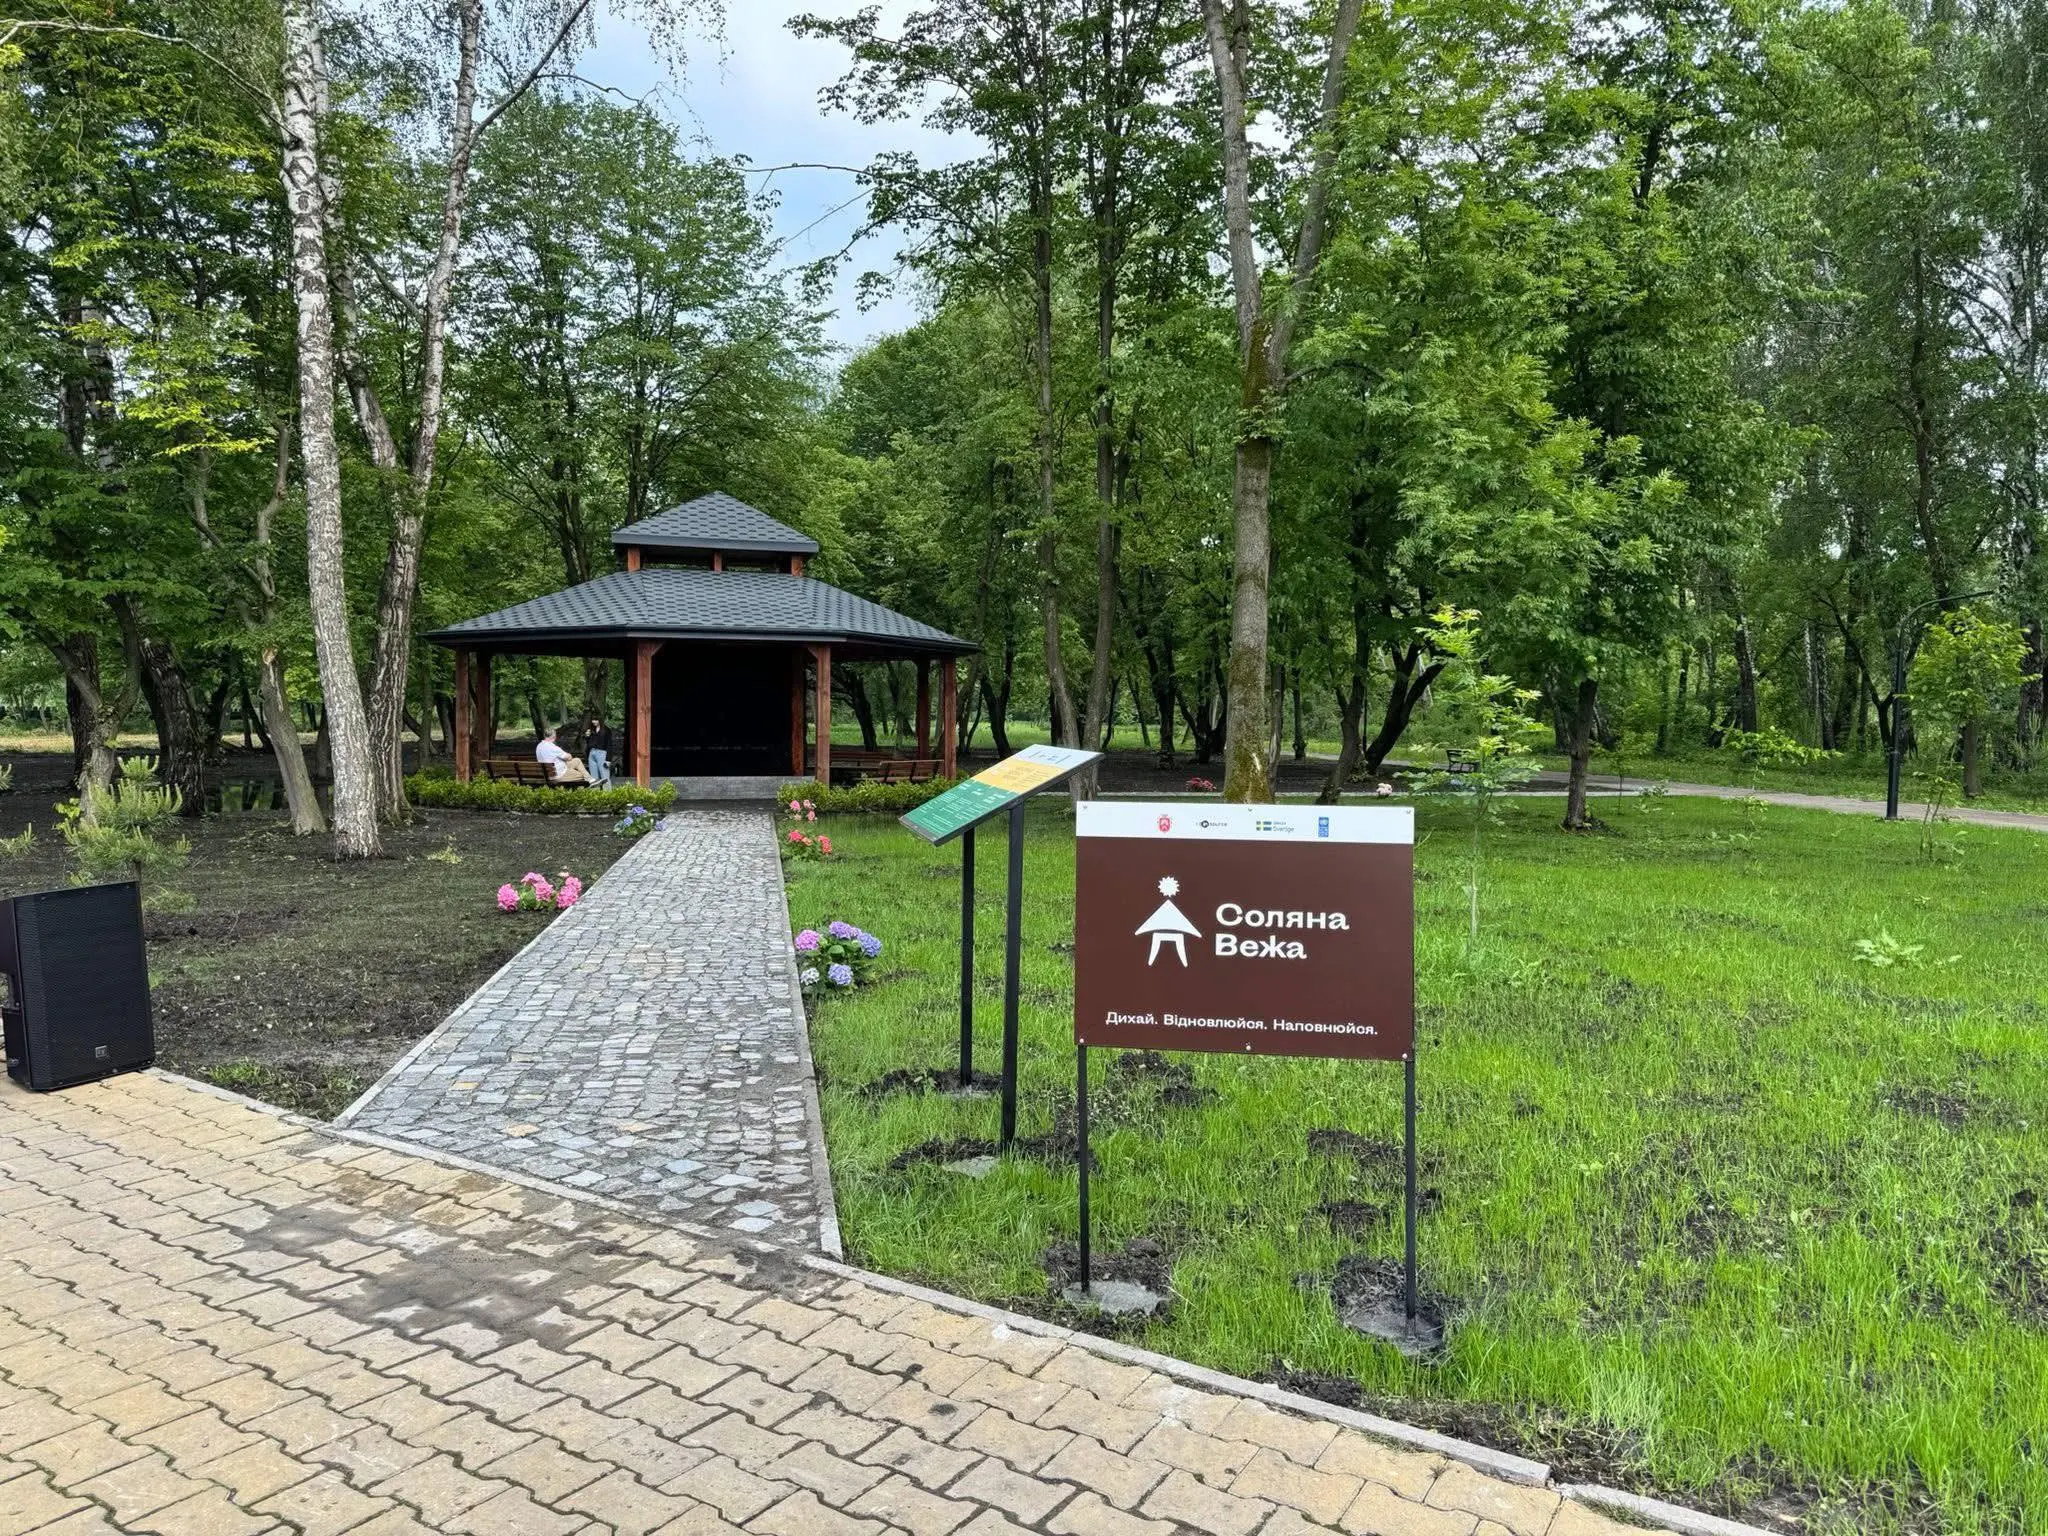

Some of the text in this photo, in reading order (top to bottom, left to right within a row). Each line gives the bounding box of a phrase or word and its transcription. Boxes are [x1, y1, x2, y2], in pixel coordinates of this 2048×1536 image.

[1272, 825, 1295, 834] Sverige
[1215, 902, 1350, 931] Соляна
[1215, 933, 1308, 960] Вежа
[1105, 1011, 1378, 1036] Дихай. Відновлюйся. Наповнюйся.
